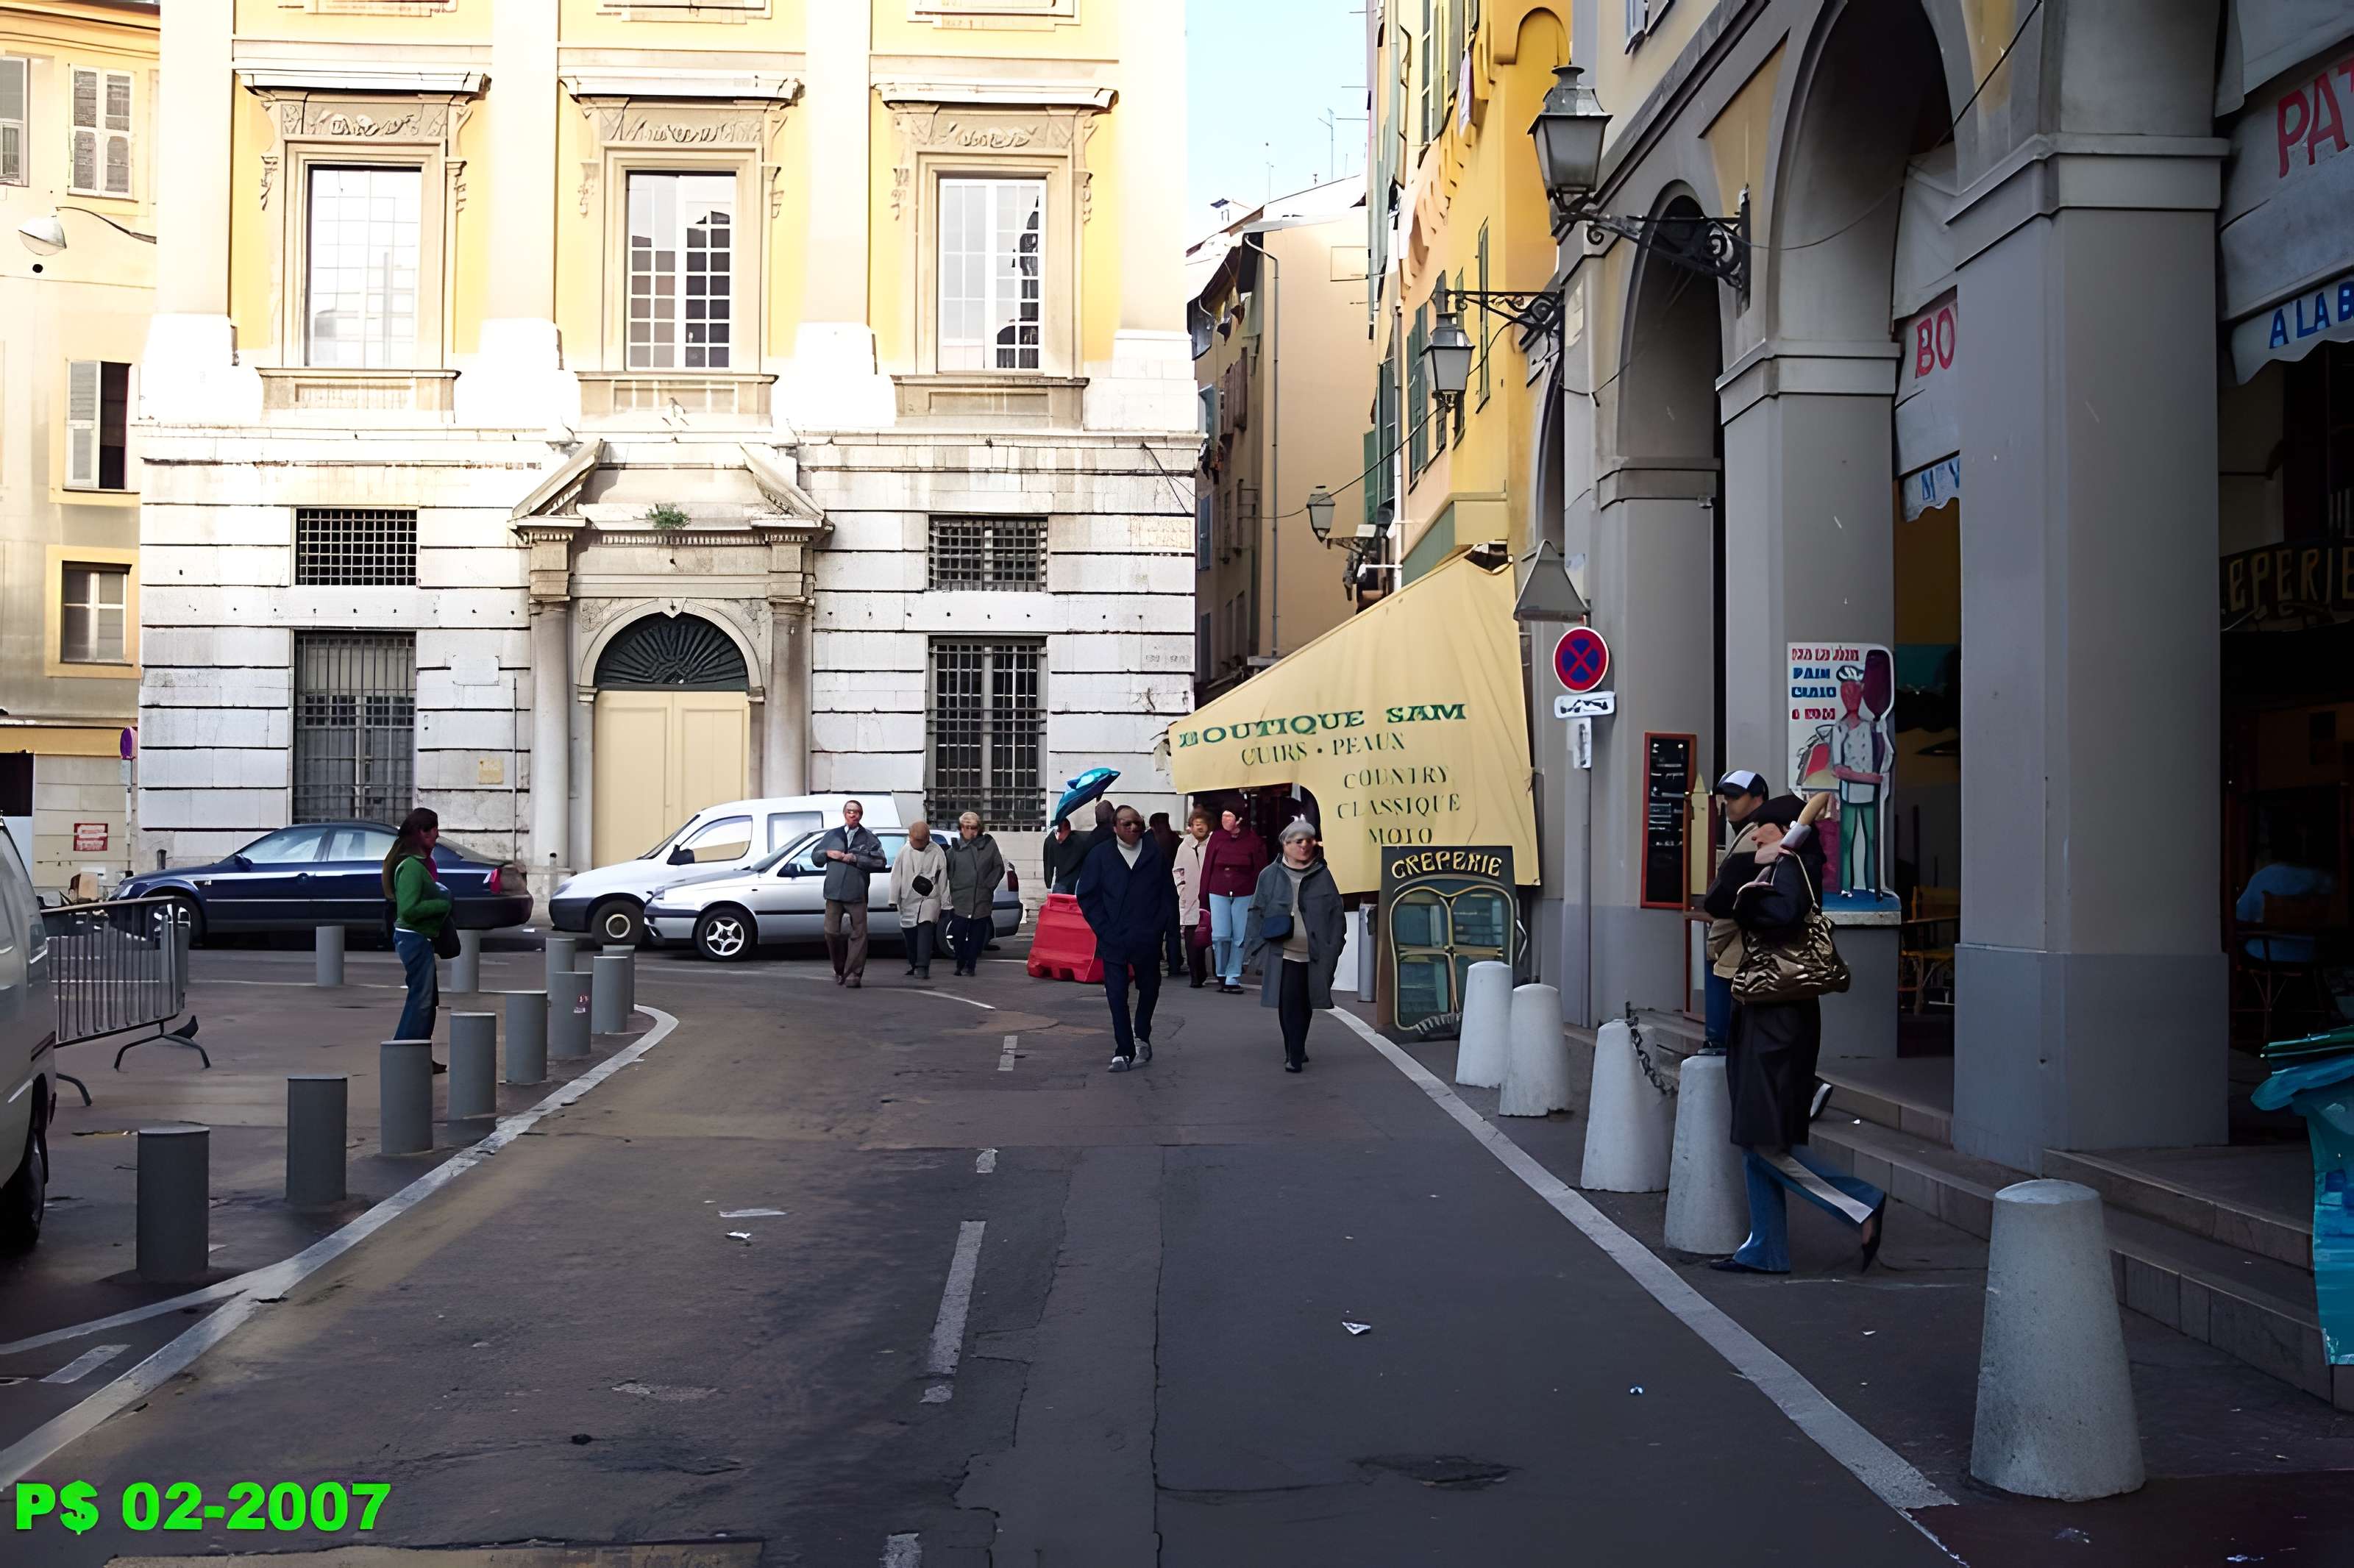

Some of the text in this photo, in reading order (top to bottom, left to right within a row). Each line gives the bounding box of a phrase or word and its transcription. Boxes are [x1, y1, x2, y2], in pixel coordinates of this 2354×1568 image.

[1914, 307, 1955, 379] BO
[2221, 547, 2354, 619] EPERIE
[1179, 704, 1466, 747] BOUTIQUE SAM
[1241, 732, 1406, 766] CUIRS PEAUX
[1344, 766, 1448, 789] COUNTRY
[1337, 794, 1461, 819] CLASSIQUE
[1368, 827, 1433, 845] MOTO
